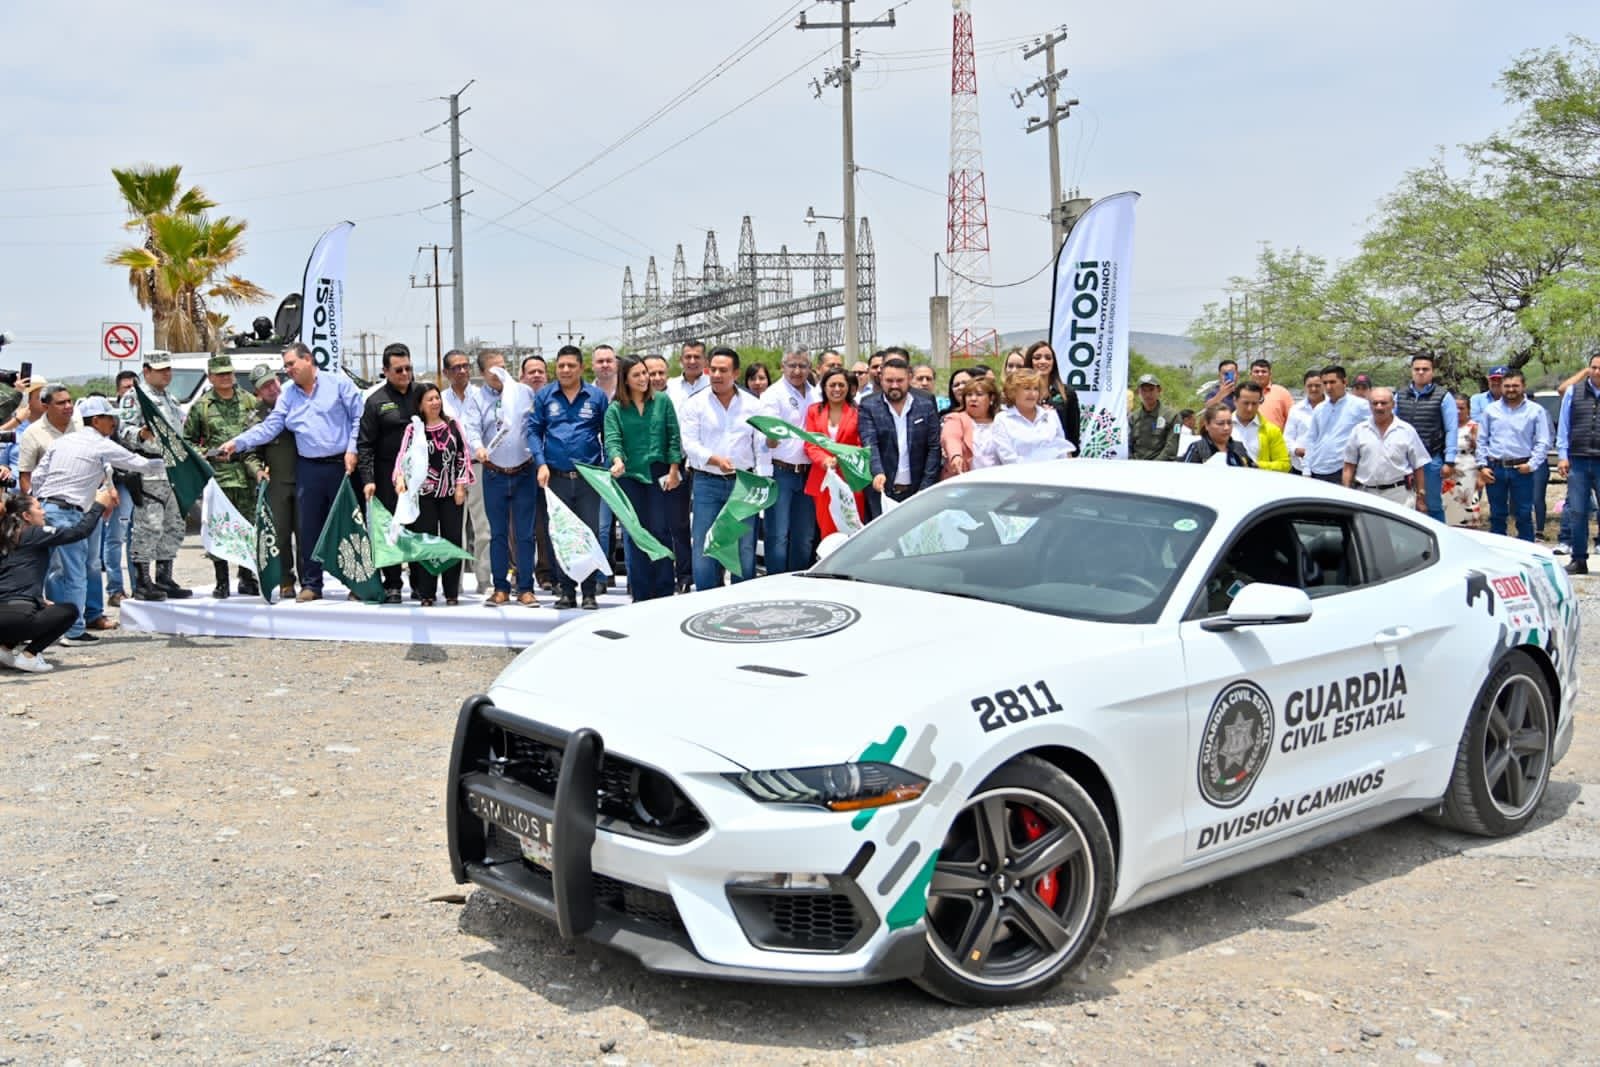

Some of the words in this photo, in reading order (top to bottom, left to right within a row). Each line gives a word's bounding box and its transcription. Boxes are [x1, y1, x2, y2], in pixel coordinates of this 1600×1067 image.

[311, 278, 331, 372] OTOSÍ
[1091, 359, 1101, 392] PARA
[1096, 334, 1104, 356] LOS
[1100, 260, 1111, 330] POTOSINOS
[970, 680, 1064, 733] 2811
[1203, 701, 1229, 764] GUARDIA
[1228, 689, 1252, 705] CIVIL
[1252, 694, 1270, 748] ESTATAL
[1280, 722, 1327, 753] CIVIL
[1332, 699, 1406, 738] ESTATAL
[1284, 664, 1408, 727] GUARDIA
[1197, 797, 1294, 850] DIVISIÓN
[1296, 769, 1385, 816] CAMINOS
